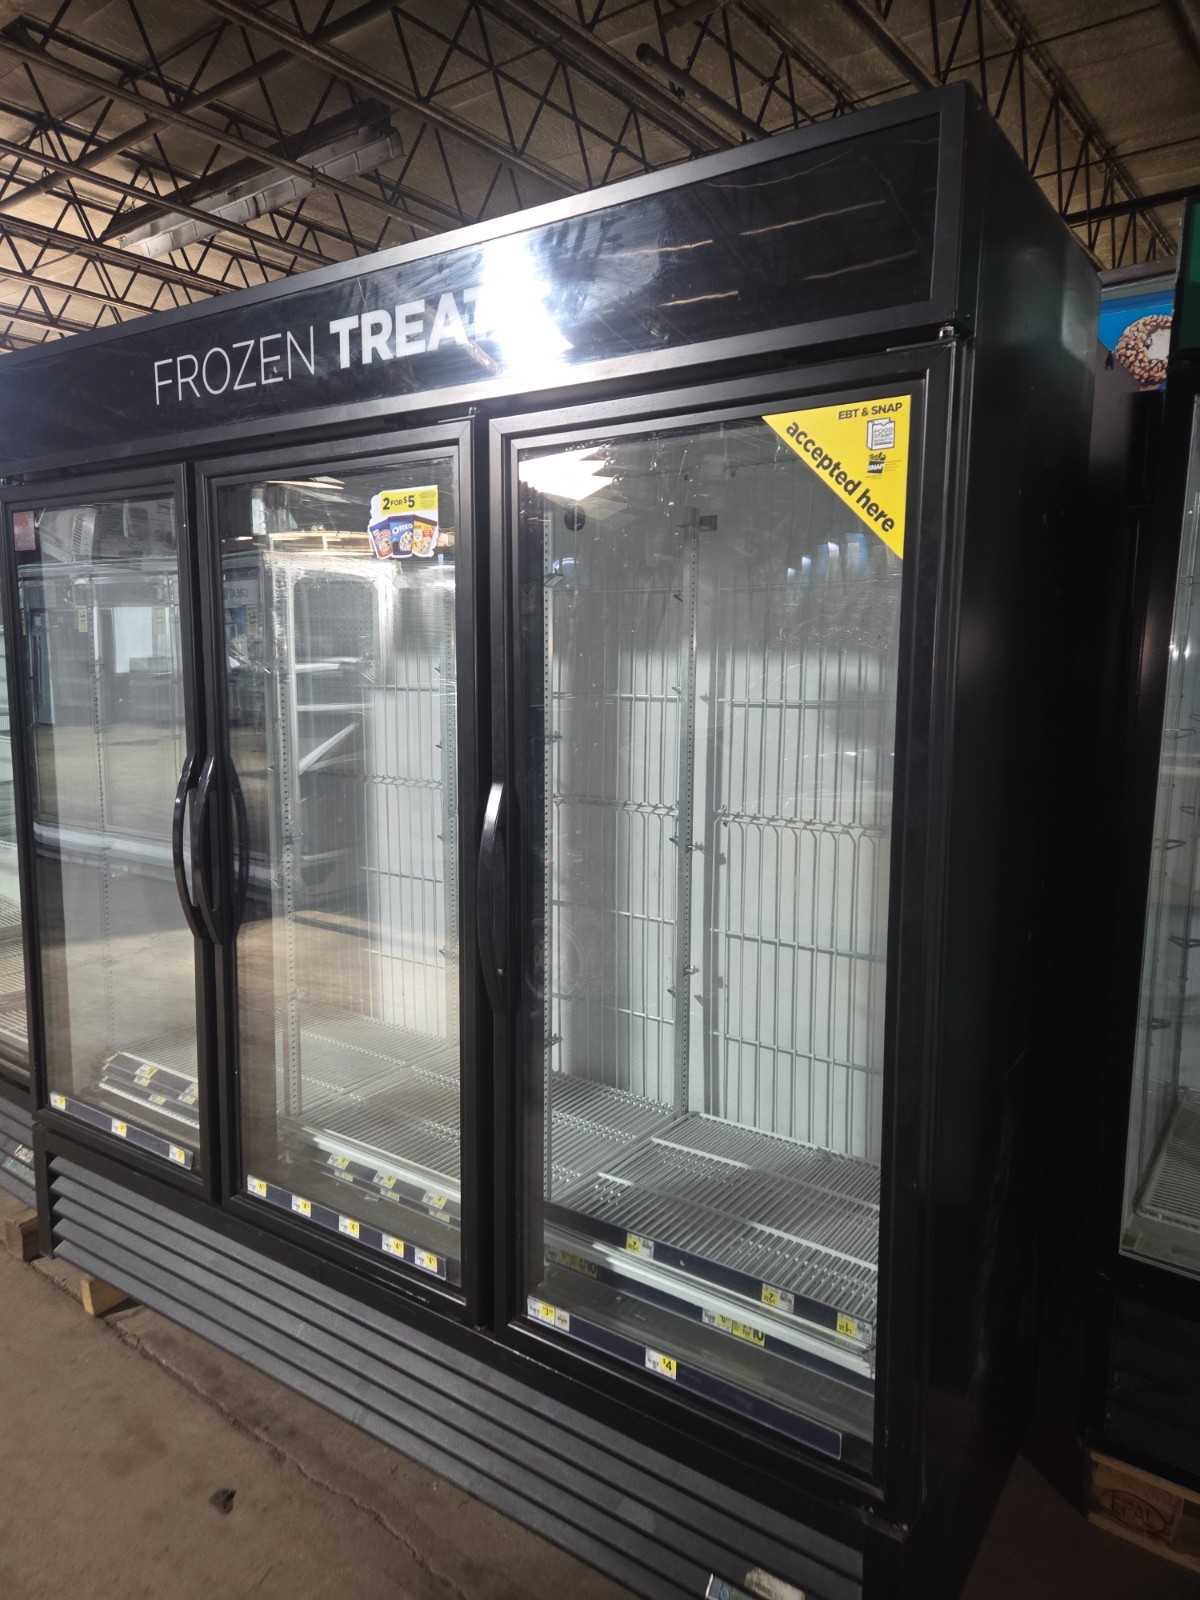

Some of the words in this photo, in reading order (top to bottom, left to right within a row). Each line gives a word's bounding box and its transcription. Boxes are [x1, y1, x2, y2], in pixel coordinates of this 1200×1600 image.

[153, 325, 315, 406] FROZEN
[838, 408, 859, 421] EBT
[861, 407, 870, 417] &
[871, 402, 903, 416] SNAP
[786, 421, 862, 497] accepted
[856, 488, 895, 533] here
[382, 497, 391, 511] 2
[390, 499, 403, 507] FOR
